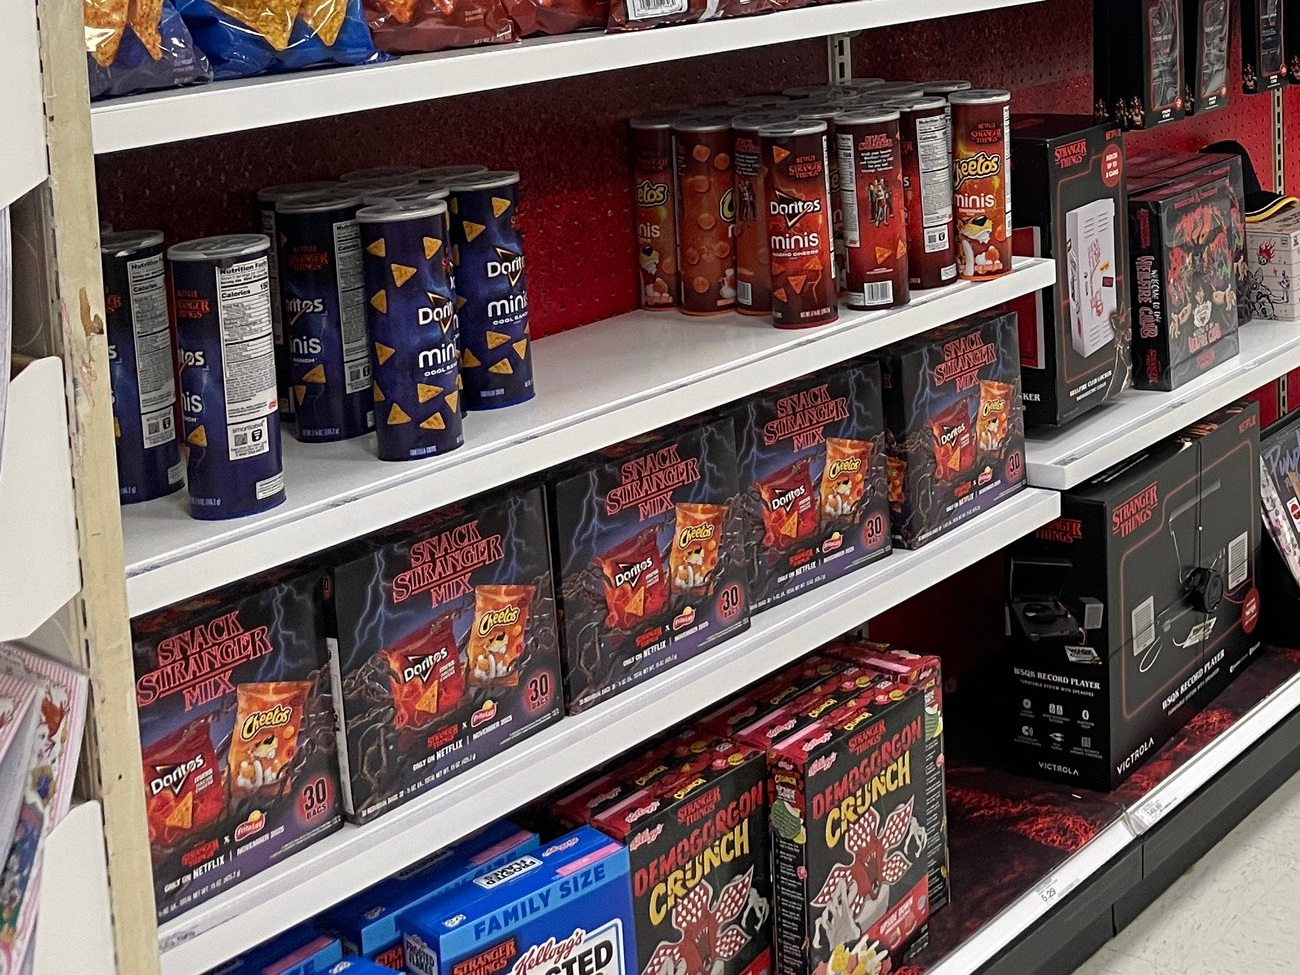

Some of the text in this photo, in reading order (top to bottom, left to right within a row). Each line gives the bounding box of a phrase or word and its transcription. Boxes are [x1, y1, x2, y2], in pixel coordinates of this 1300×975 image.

[1054, 139, 1088, 163] STRANGER
[1060, 154, 1083, 169] THINGS
[770, 199, 820, 215] Doritos
[954, 193, 995, 209] minis
[771, 231, 819, 250] minis
[220, 264, 253, 275] Nutrition
[221, 288, 251, 299] Calories
[943, 331, 984, 360] SNACK
[935, 342, 997, 386] STRANGER
[956, 370, 981, 393] MIX
[776, 384, 831, 417] SNACK
[982, 397, 1005, 419] Cheetos
[764, 394, 850, 446] STRANGER
[941, 423, 966, 446] Doritos
[793, 428, 826, 453] MIX
[621, 444, 681, 483] SNACK
[828, 457, 861, 481] Cheetos
[1009, 452, 1020, 472] 30
[606, 457, 701, 516] STRANGER
[772, 483, 805, 512] Doritos
[639, 491, 674, 521] MIX
[1112, 482, 1158, 531] STRANGER
[679, 523, 715, 549] Cheetos
[867, 515, 882, 538] 30
[1036, 529, 1074, 544] THINGS
[1120, 507, 1153, 537] THINGS
[411, 521, 482, 566] SNACK
[392, 534, 504, 603] STRANGER
[616, 556, 653, 587] Doritos
[795, 561, 817, 577] NETFLIX
[431, 573, 474, 608] MIX
[722, 586, 738, 613] 30
[478, 606, 520, 636] Cheetos
[158, 610, 245, 666] SNACK
[643, 640, 666, 658] NETFLIX
[137, 625, 273, 707] STRANGER
[404, 647, 448, 682] Doritos
[1180, 668, 1204, 695] RECORD
[1203, 649, 1226, 676] PLAYER
[183, 669, 237, 711] MIX
[529, 673, 549, 704] 30
[1037, 672, 1068, 685] RECORD
[1070, 679, 1101, 690] PLAYER
[241, 705, 292, 740] Cheetos
[848, 720, 886, 753] STRANGER
[436, 739, 463, 761] NETFLIX
[856, 734, 882, 756] THINGS
[1116, 737, 1155, 775] VICTROLA
[151, 754, 205, 795] Doritos
[812, 716, 922, 820] DEMOGORGON
[1039, 761, 1079, 776] VICTROLA
[303, 777, 327, 811] 30
[674, 777, 707, 800] CRUNCH
[677, 786, 721, 820] STRANGER
[825, 750, 911, 848] CRUNCH
[306, 803, 328, 820] BAGS
[685, 802, 716, 826] THINGS
[635, 780, 763, 897] DEMOGORGON
[193, 854, 225, 879] NETFLIX
[649, 817, 750, 926] CRUNCH
[474, 862, 606, 941] FAMILY SIZE
[1041, 887, 1057, 902] 5.29
[453, 939, 516, 975] STRANGER
[514, 929, 587, 974] Kellogg's
